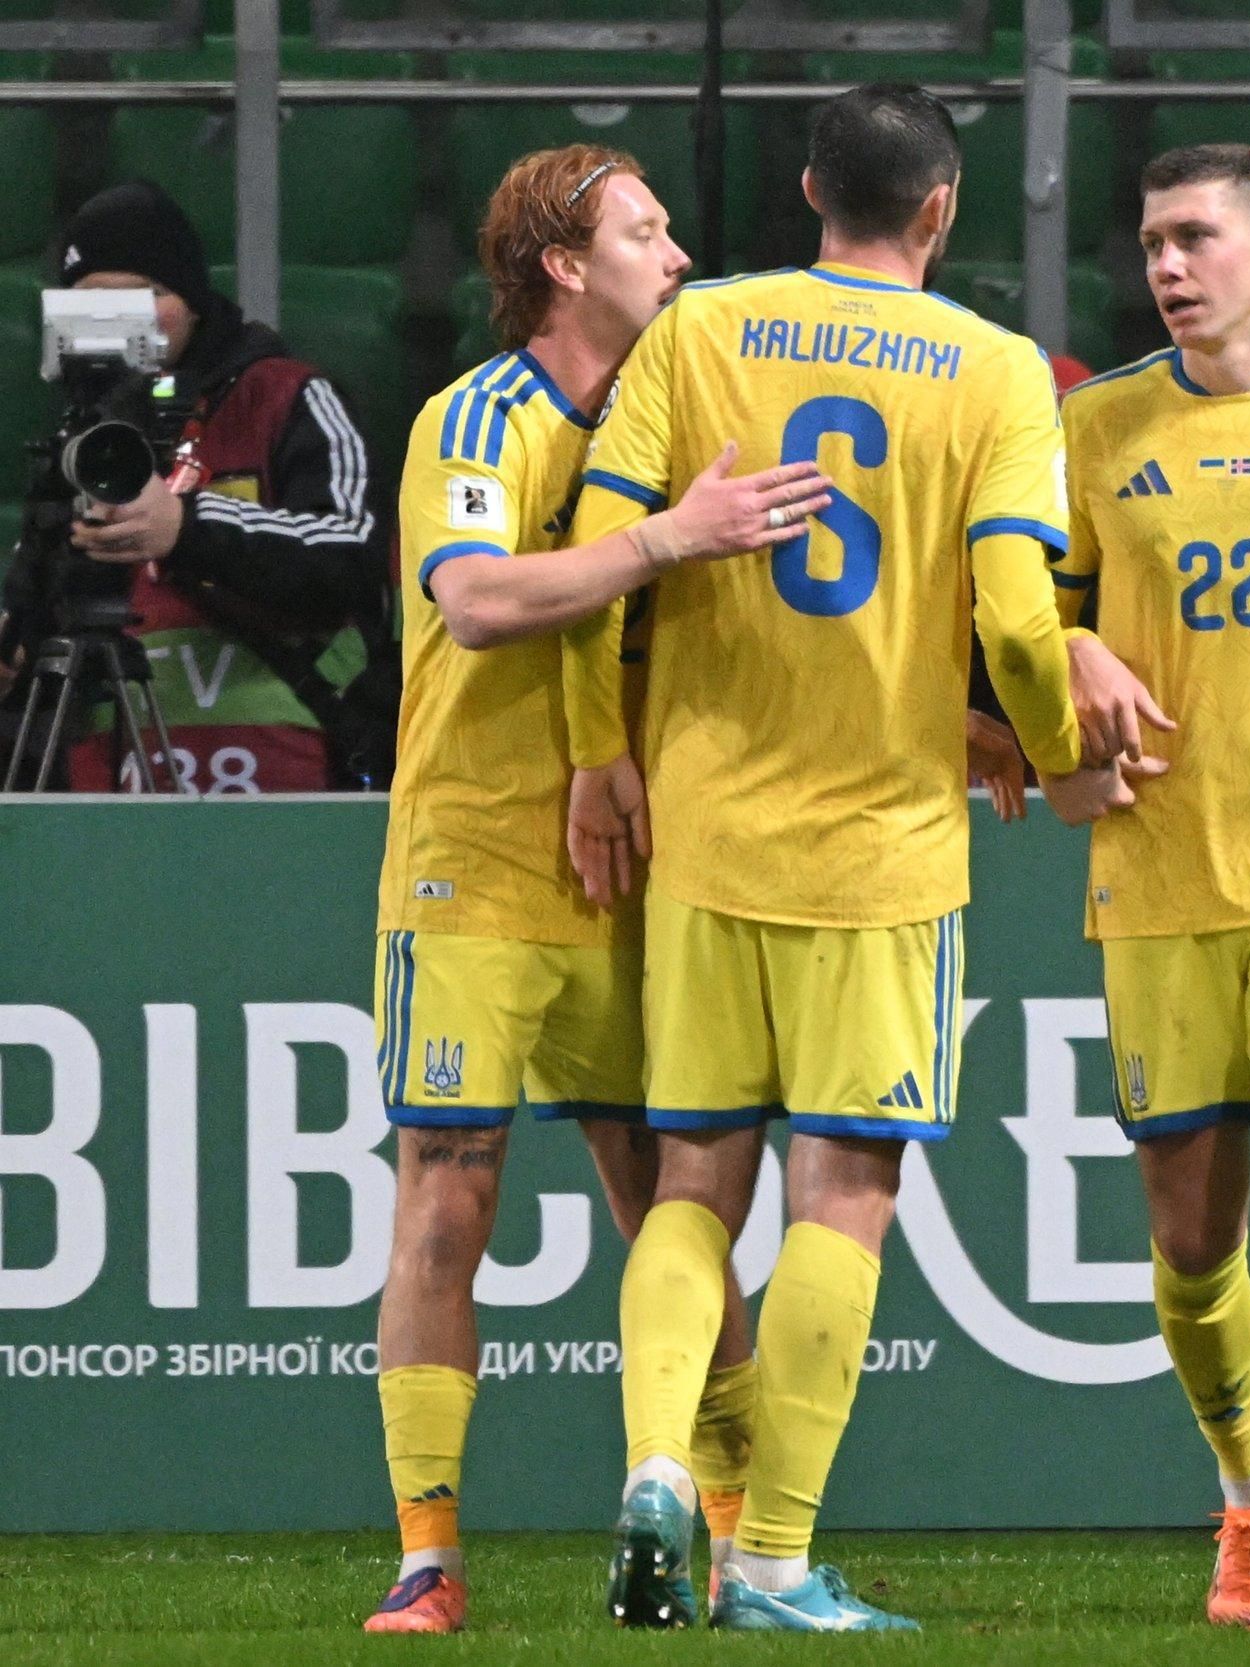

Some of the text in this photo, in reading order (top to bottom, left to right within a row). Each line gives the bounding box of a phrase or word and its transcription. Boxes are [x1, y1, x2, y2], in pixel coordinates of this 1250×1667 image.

[740, 317, 962, 381] KALIUZHNYI
[771, 395, 889, 617] 6
[166, 1335, 323, 1376] ЗБІРНОЇ
[329, 1342, 535, 1380] КОДИ
